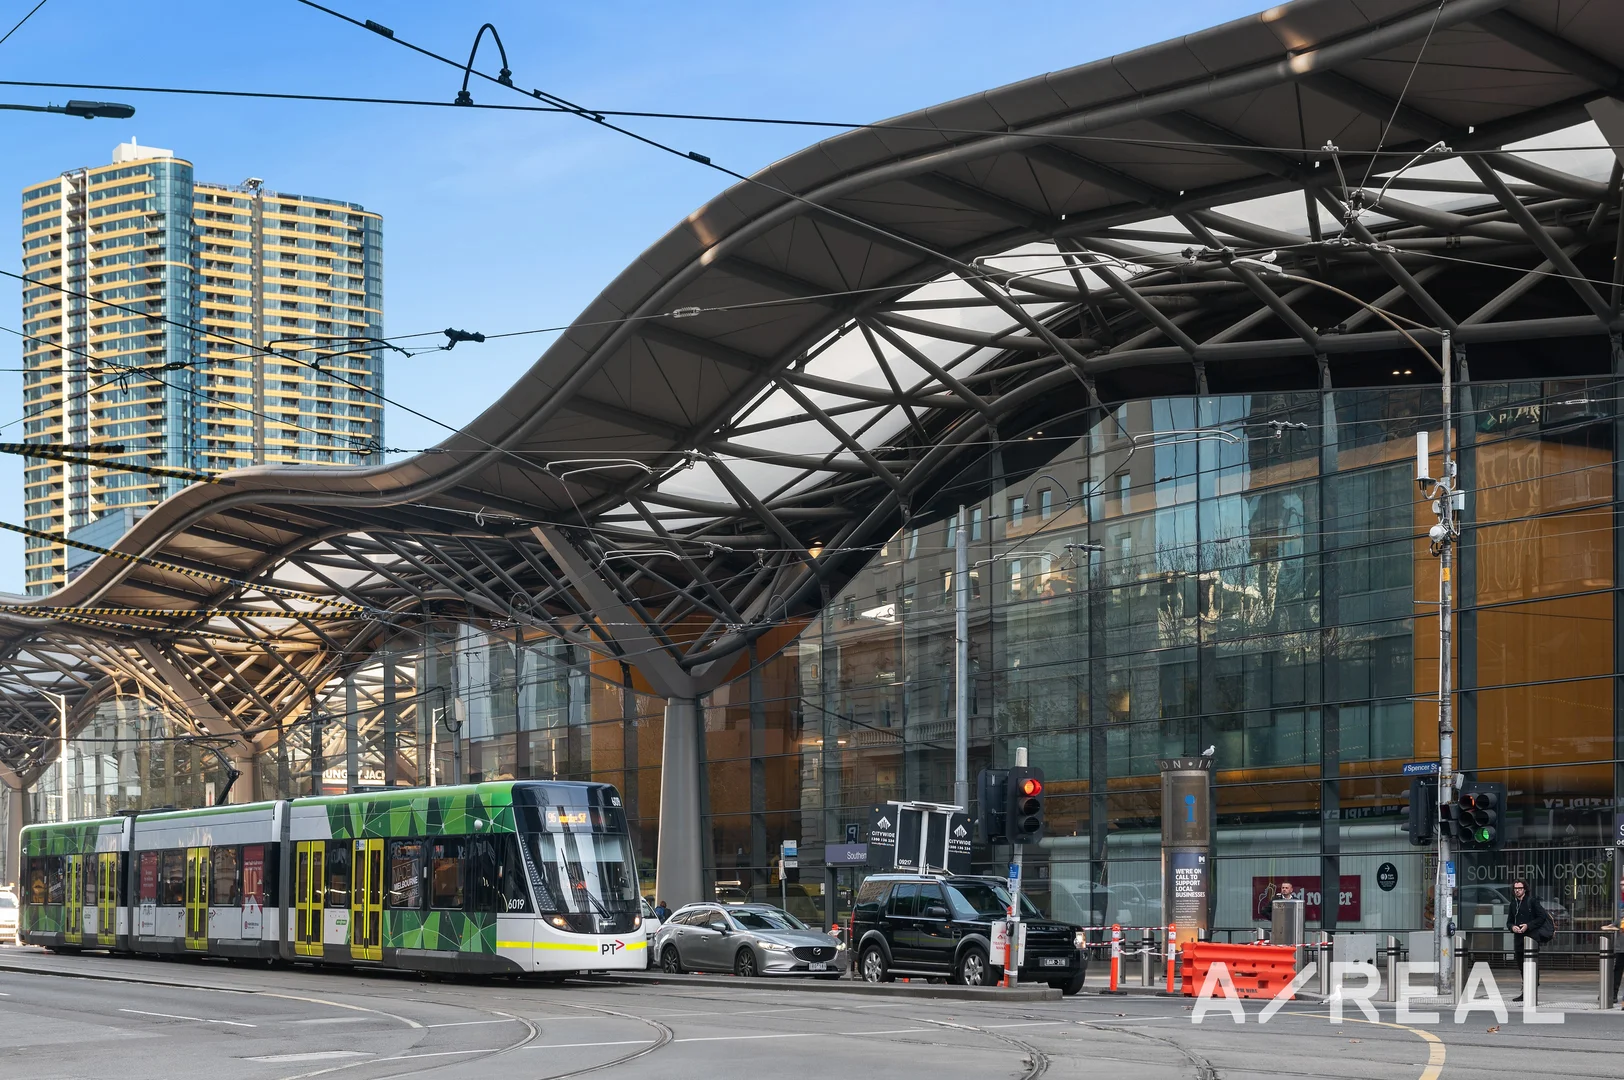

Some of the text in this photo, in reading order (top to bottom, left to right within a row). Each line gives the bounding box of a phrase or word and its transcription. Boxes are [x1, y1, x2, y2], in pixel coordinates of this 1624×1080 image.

[1407, 764, 1430, 773] Spencer
[871, 830, 896, 838] CITYWIDE
[948, 838, 972, 846] CITYWIDE
[1467, 862, 1607, 881] SOUTHERN CROSS
[1564, 884, 1607, 896] STATION
[508, 898, 525, 910] 6019
